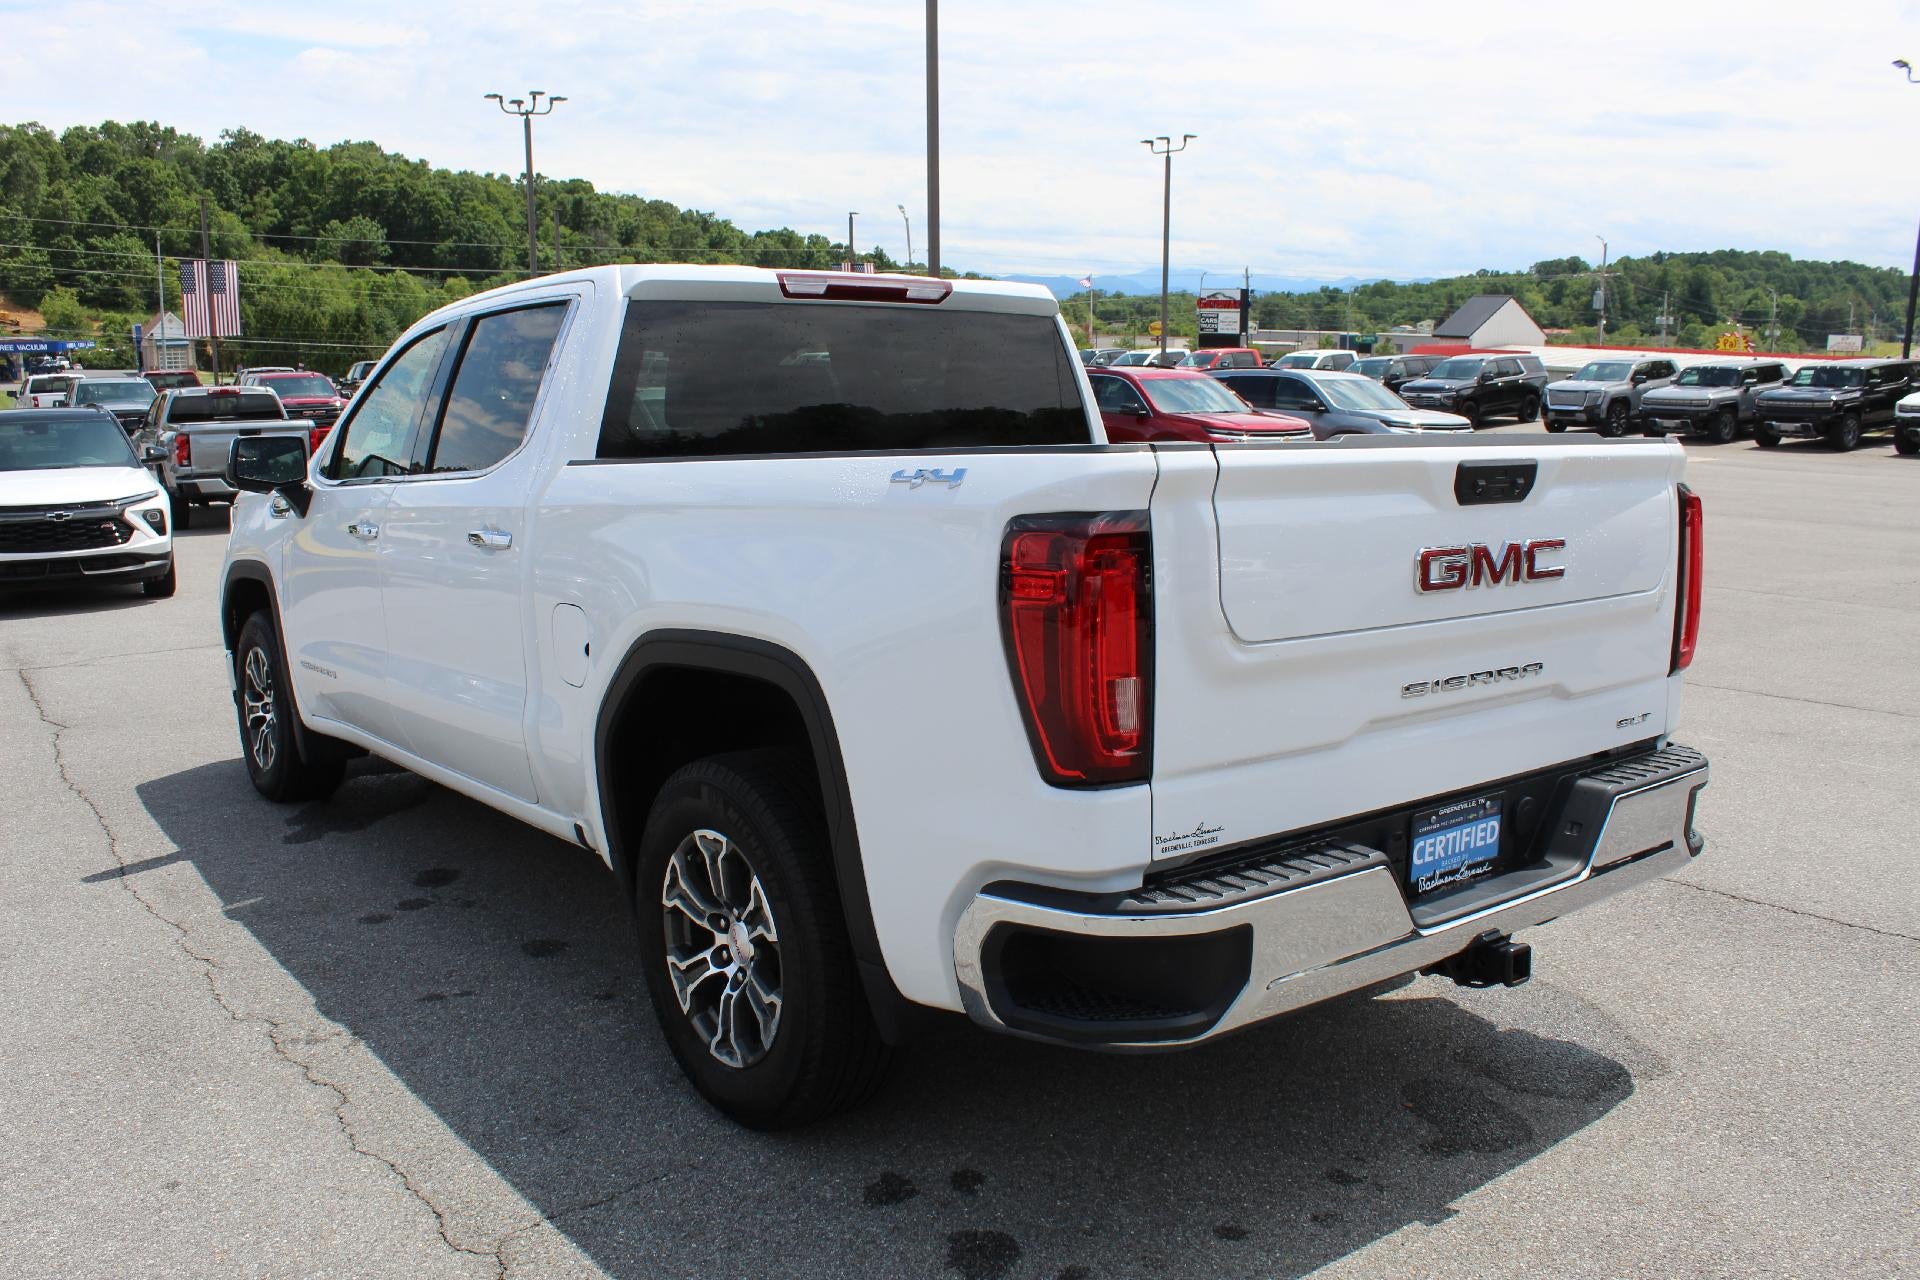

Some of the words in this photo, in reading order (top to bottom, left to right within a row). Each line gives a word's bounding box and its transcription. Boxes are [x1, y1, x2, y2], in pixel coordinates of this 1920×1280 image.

[16, 343, 48, 351] VACUUM
[1413, 536, 1567, 594] GMC
[1401, 661, 1544, 699] SIERRA
[1616, 711, 1652, 729] SLT
[1438, 801, 1477, 815] GREENEVILLE,
[1161, 841, 1193, 854] GREENEVILLE,
[1194, 836, 1219, 847] TENNESSEE
[1413, 821, 1498, 864] CERTIFIED
